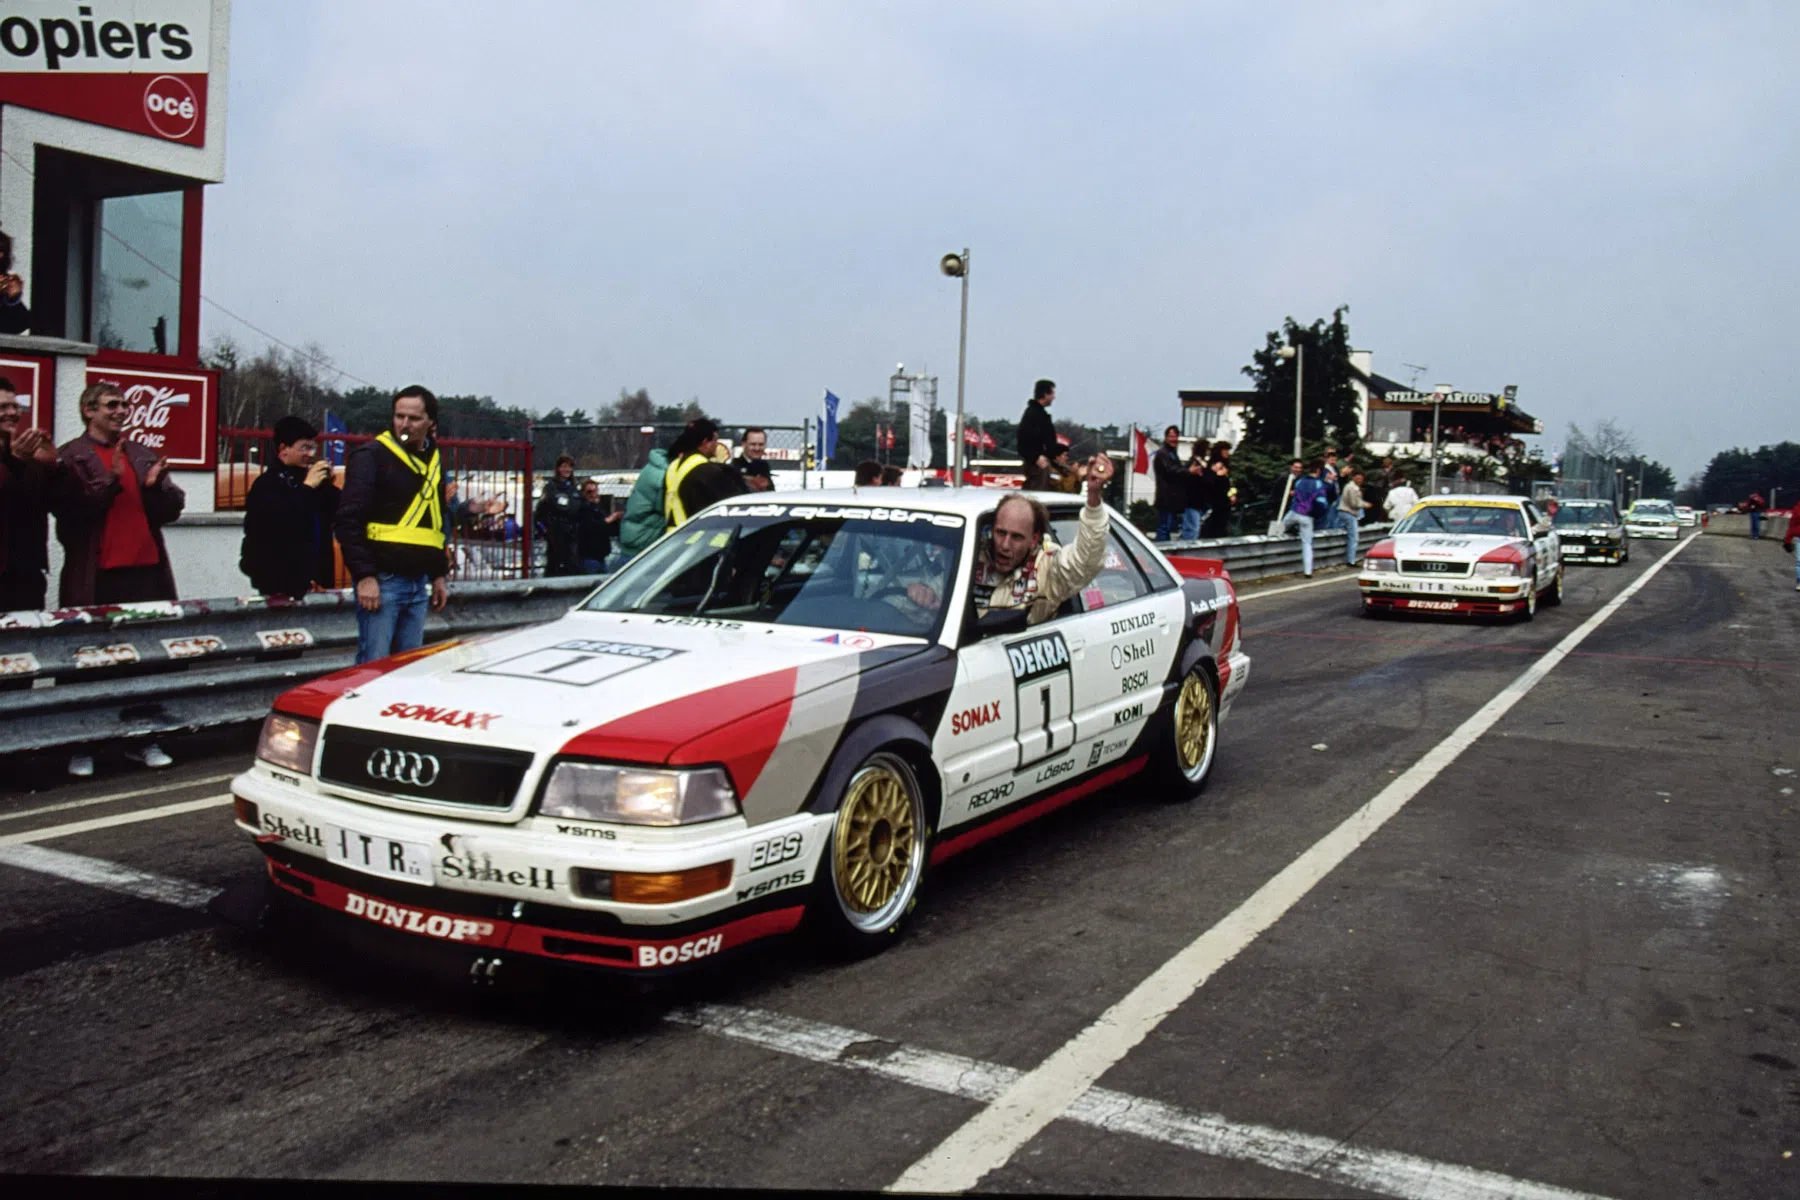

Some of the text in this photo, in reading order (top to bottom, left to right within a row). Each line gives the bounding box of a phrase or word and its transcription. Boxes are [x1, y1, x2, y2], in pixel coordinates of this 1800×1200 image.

[147, 92, 195, 119] océ
[1445, 393, 1491, 404] ARTOIS
[700, 504, 964, 528] Audi quattro
[1407, 600, 1459, 611] DUNLOP
[1110, 612, 1156, 635] DUNLOP
[1008, 636, 1068, 678] DEKRA
[1123, 638, 1155, 664] Shell
[535, 656, 600, 674] 1
[1122, 670, 1149, 694] BOSCH
[951, 700, 1001, 736] SONAX
[1039, 685, 1055, 752] 1
[1114, 703, 1143, 726] KONI
[967, 780, 1016, 811] RECARO
[263, 812, 323, 848] Shell
[442, 850, 555, 890] Shell
[749, 832, 802, 872] BBS
[345, 893, 495, 941] DUNLOP
[638, 933, 723, 968] BOSCH
